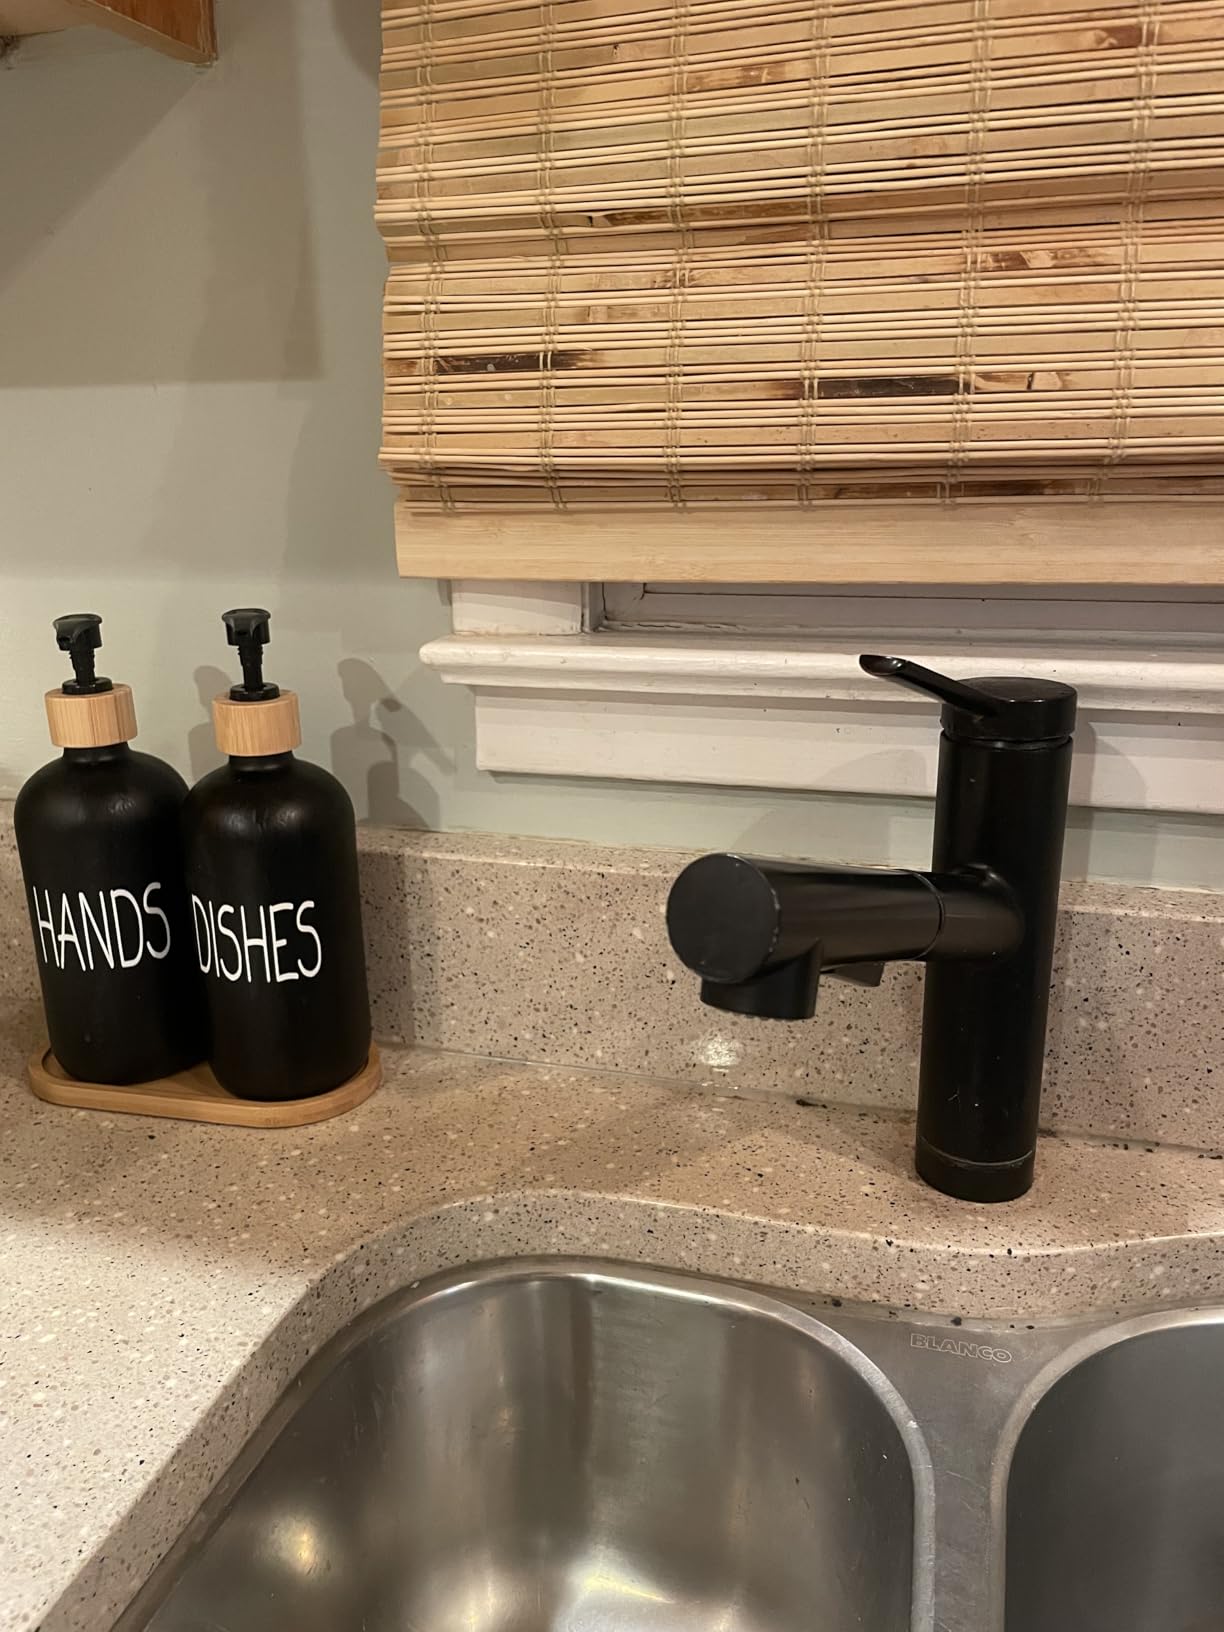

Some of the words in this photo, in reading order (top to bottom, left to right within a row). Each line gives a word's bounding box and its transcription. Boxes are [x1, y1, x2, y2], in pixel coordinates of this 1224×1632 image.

[33, 881, 171, 971] HANDS
[191, 894, 322, 983] DISHES
[910, 1333, 1012, 1363] BLANCO
